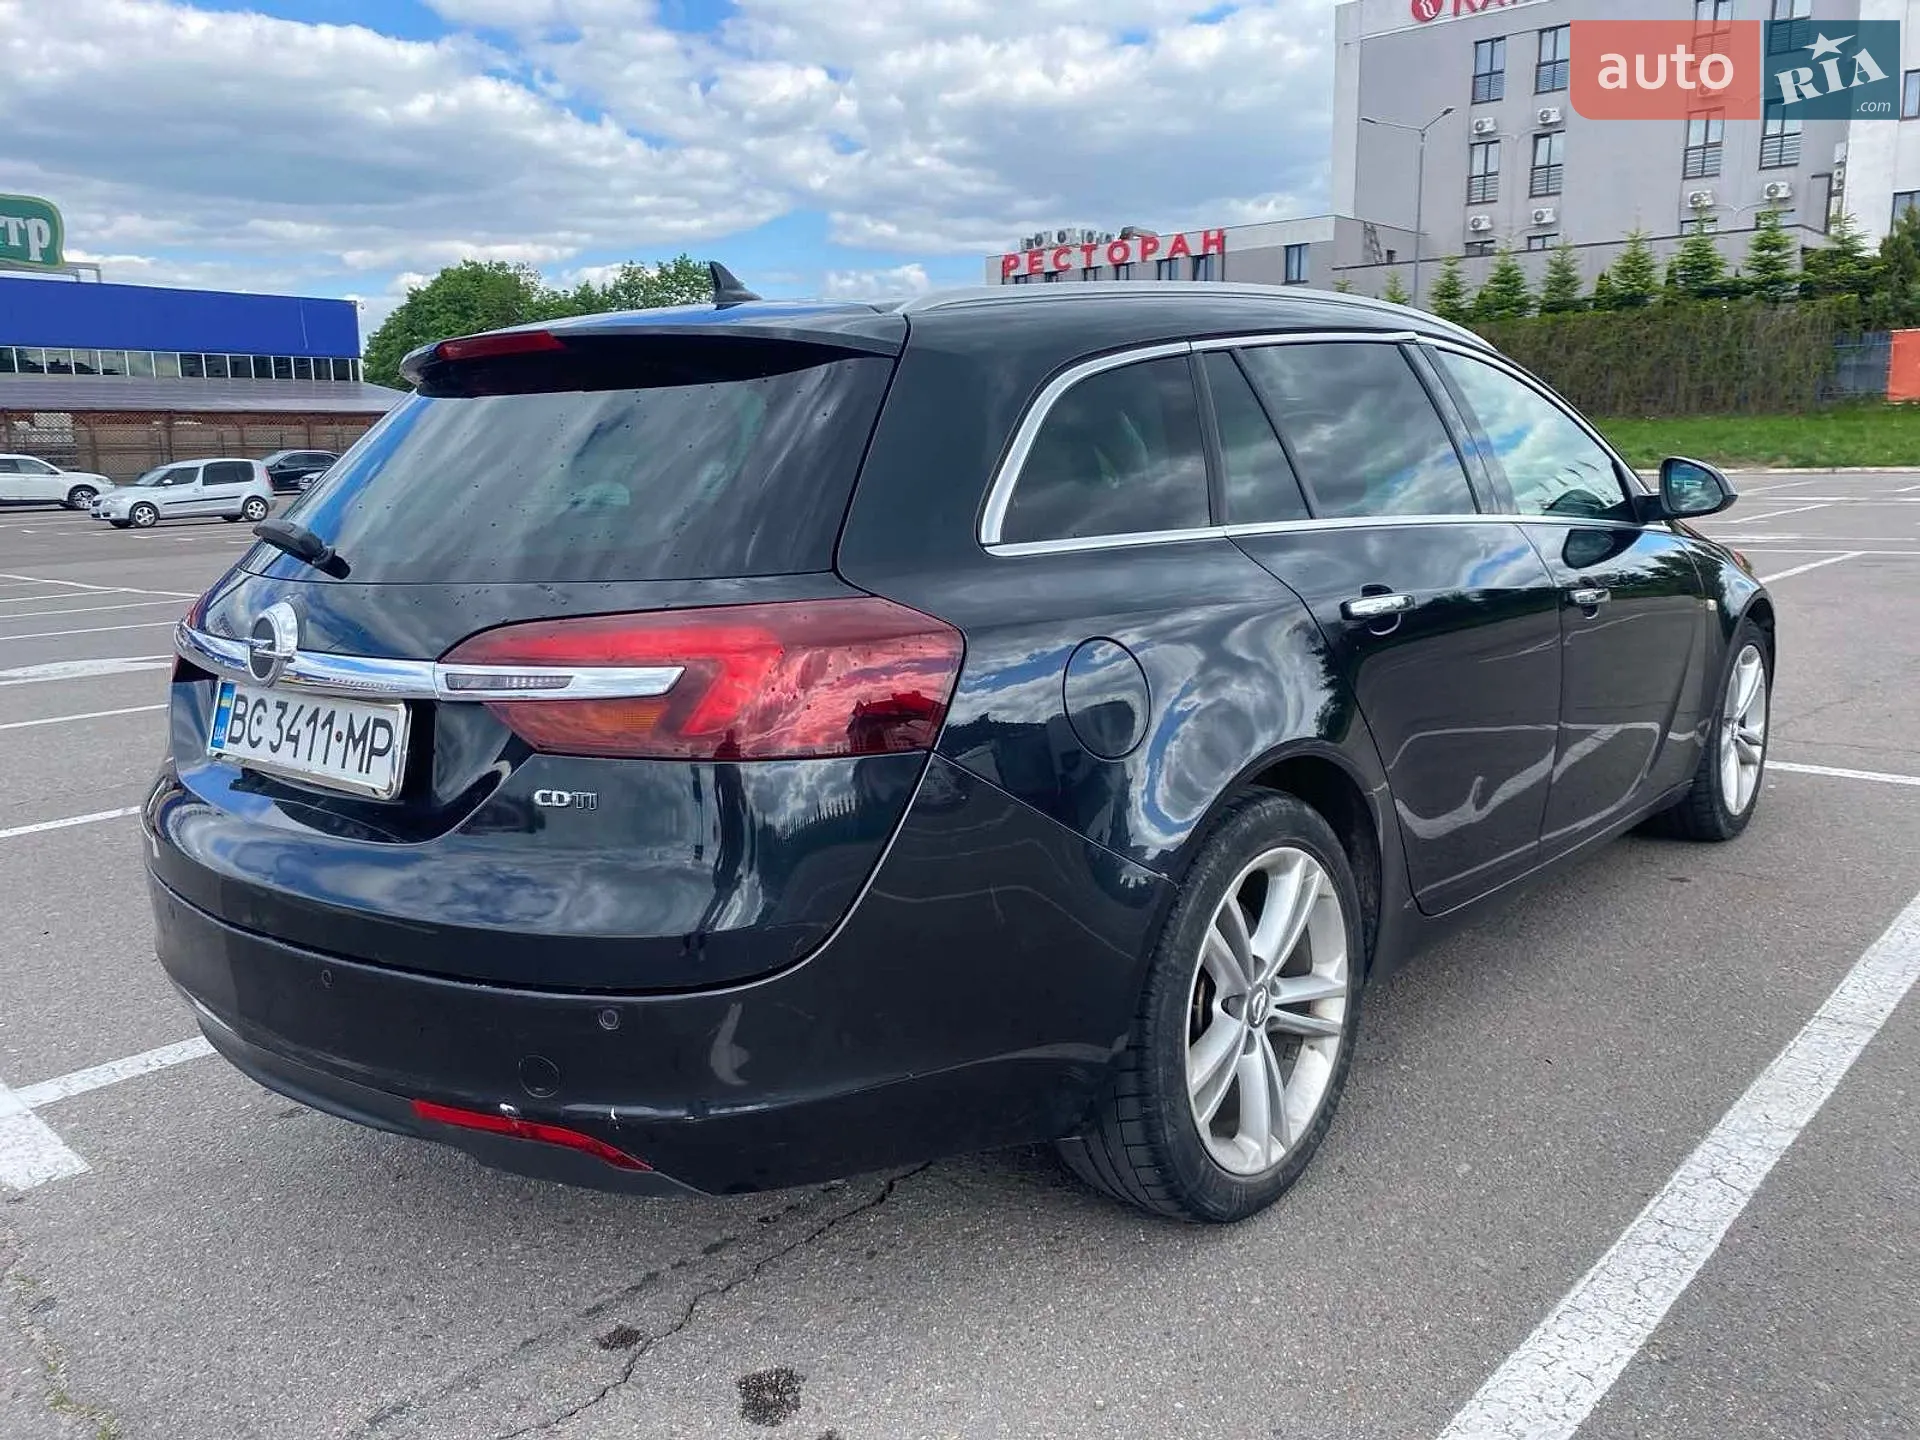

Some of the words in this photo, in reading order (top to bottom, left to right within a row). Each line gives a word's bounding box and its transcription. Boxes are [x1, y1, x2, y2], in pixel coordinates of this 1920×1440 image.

[1002, 228, 1225, 278] РЕСТОРАН
[269, 700, 337, 766] 3411
[341, 711, 395, 775] MP
[533, 789, 598, 810] CDTI
